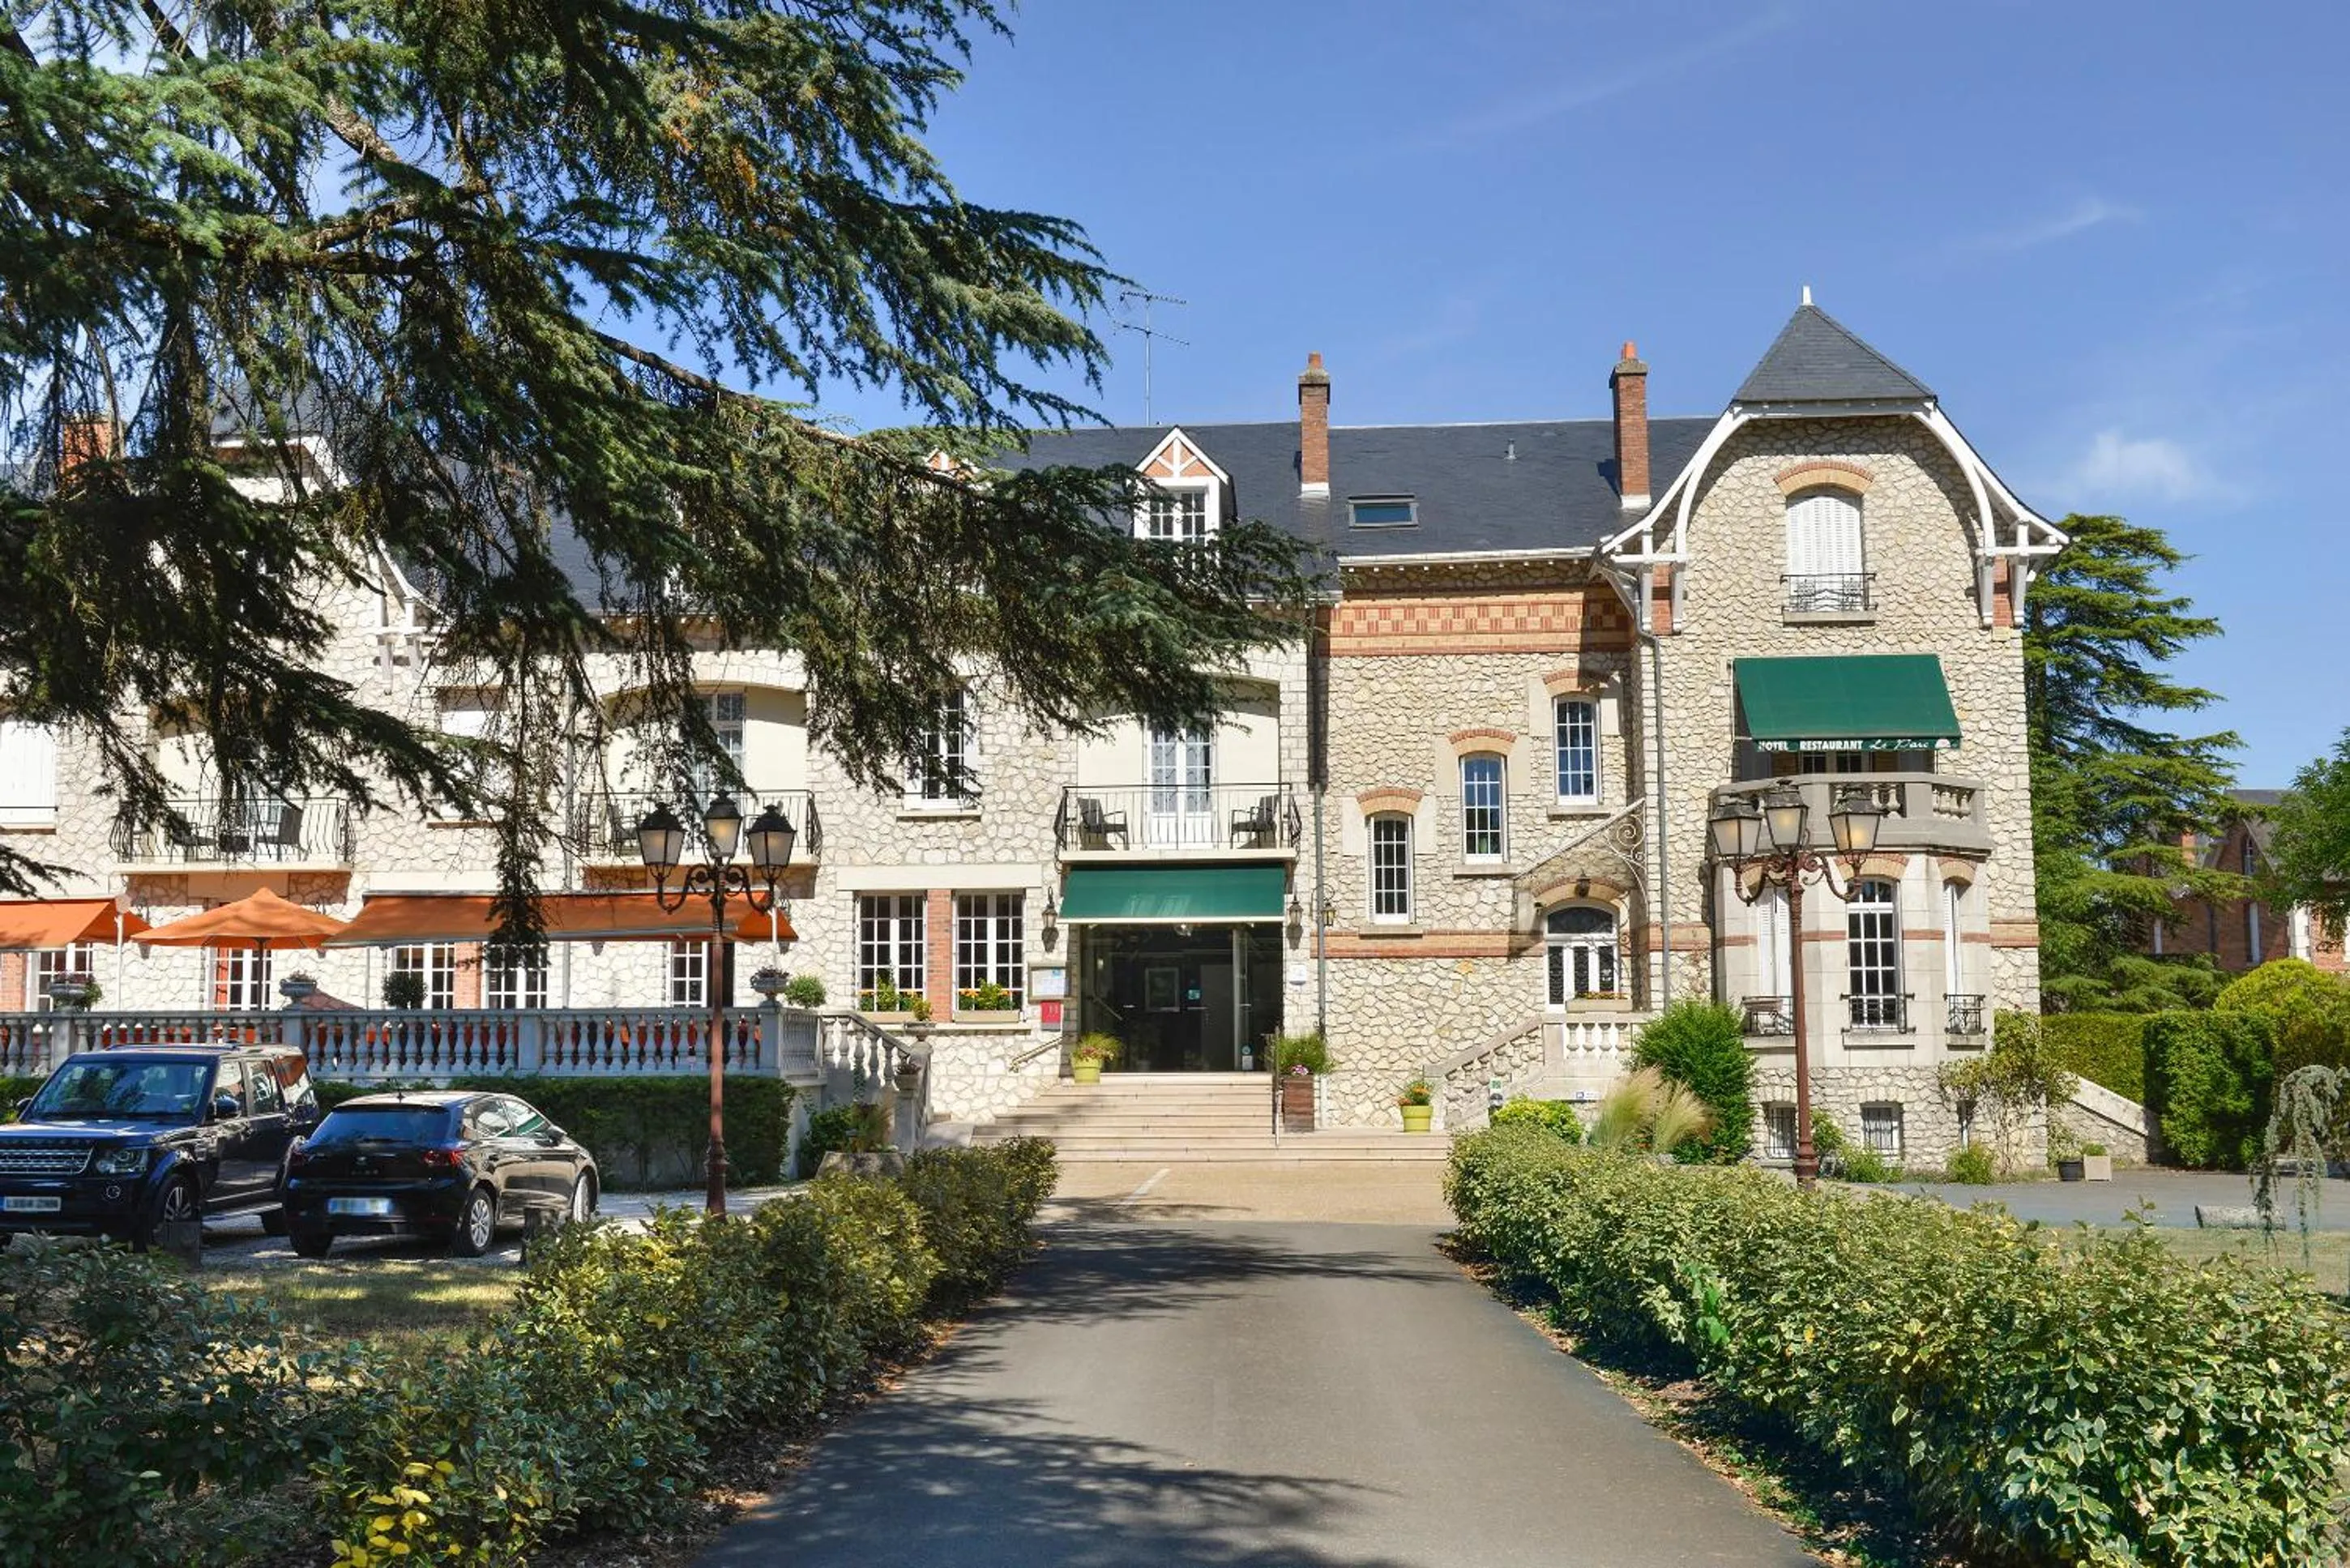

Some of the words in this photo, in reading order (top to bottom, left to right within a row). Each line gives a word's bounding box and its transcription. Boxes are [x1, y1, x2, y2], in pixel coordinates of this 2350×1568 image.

[1800, 741, 1863, 750] RESTAURANT
[1869, 738, 1886, 750] Le
[1893, 738, 1929, 750] Parc
